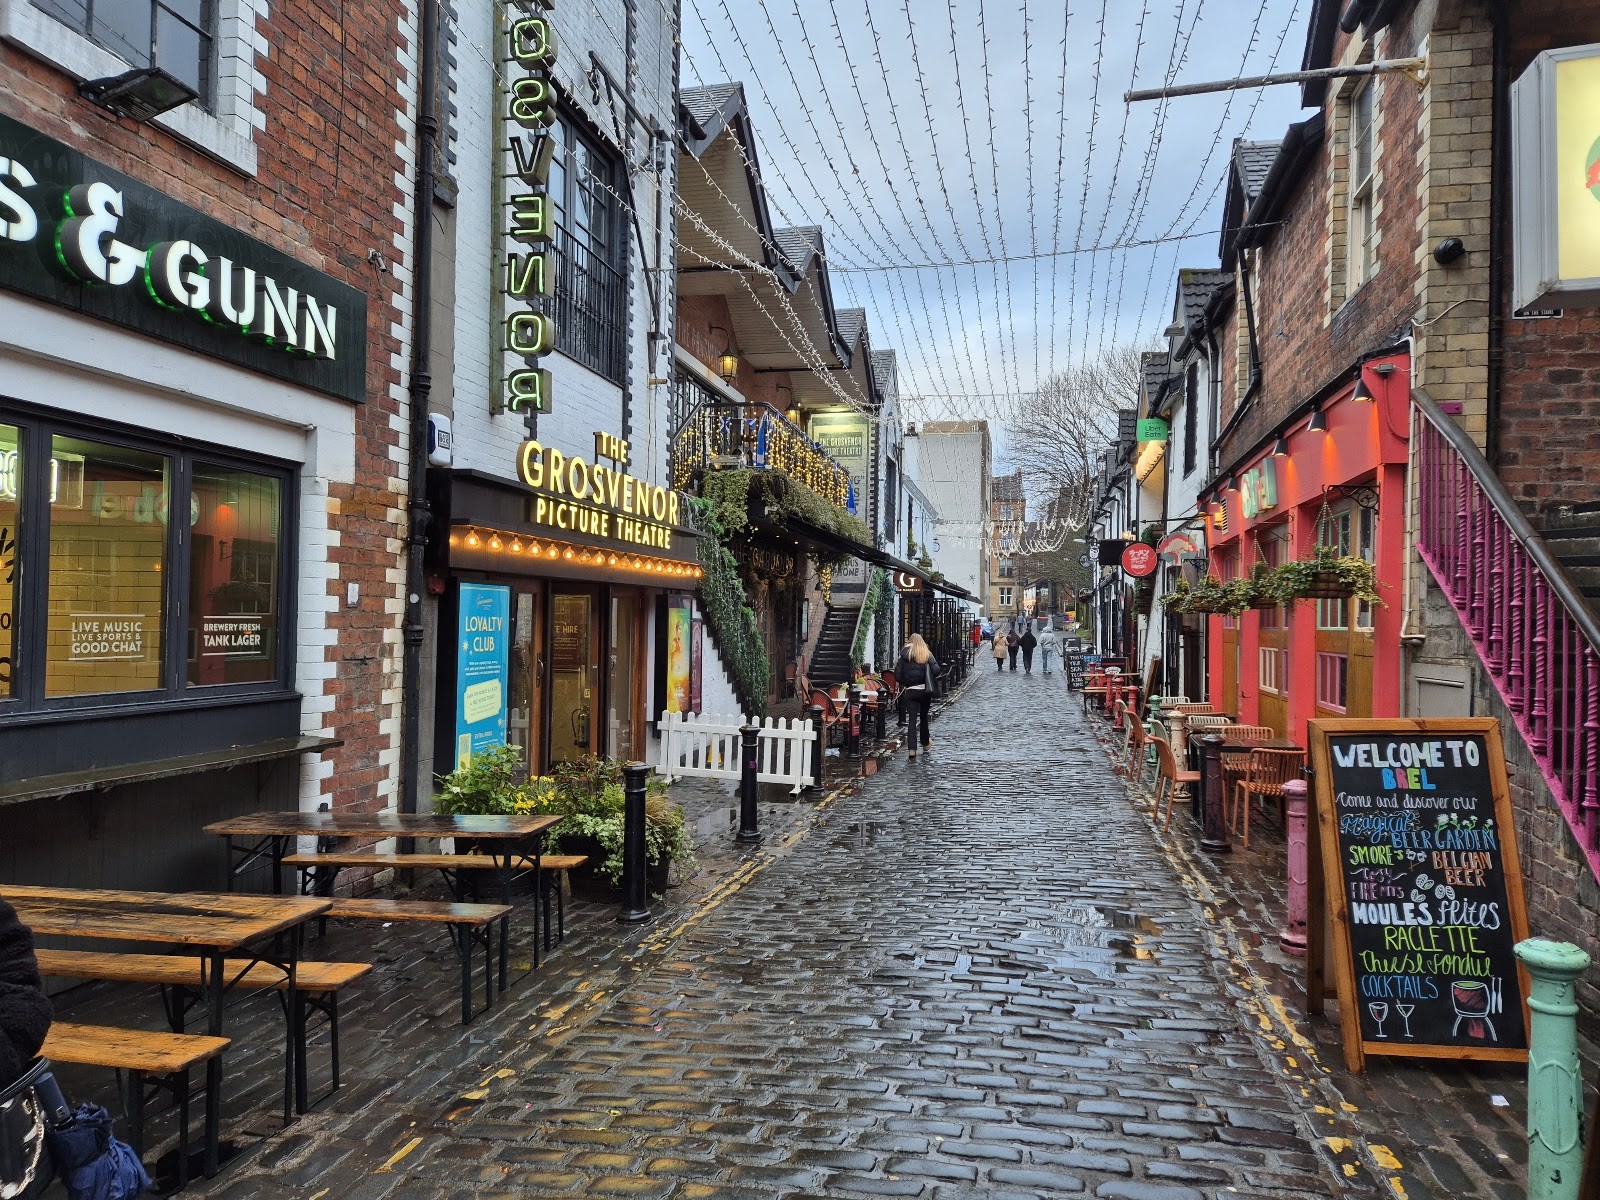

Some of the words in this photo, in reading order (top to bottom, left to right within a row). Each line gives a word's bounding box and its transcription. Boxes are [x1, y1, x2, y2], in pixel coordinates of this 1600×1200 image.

[79, 181, 149, 286] &
[166, 240, 337, 361] GUNN
[594, 432, 631, 464] THE
[830, 436, 861, 446] GROSVENOR
[840, 446, 861, 455] THEATRE
[518, 440, 679, 527] GROSVENOR
[537, 502, 609, 538] PICTURE
[617, 516, 672, 550] THEATRE
[71, 622, 99, 633] LIVE
[103, 622, 142, 632] MUSIC
[204, 623, 237, 631] BREWERY
[239, 623, 261, 631] FRESH
[465, 616, 502, 632] LOYALTY
[562, 625, 578, 634] HIRE
[97, 633, 132, 641] SPORTS
[203, 634, 229, 646] TANK
[231, 634, 261, 646] LAGER
[473, 636, 494, 652] CLUB
[71, 642, 109, 654] GOOD
[111, 641, 142, 653] CHAT
[1333, 741, 1444, 768] WELCOME
[1445, 740, 1480, 768] TO
[1381, 769, 1436, 790] BREL
[1335, 791, 1372, 808] Come
[1376, 793, 1398, 808] and
[1403, 793, 1449, 808] discover
[1452, 797, 1478, 809] our
[1391, 830, 1432, 849] BEER
[1434, 829, 1497, 850] GARDEN
[1432, 851, 1493, 870] BELGIAN
[1445, 870, 1487, 887] BEER
[1351, 902, 1434, 926] MOULES
[1384, 926, 1487, 954] RACLETTE
[1360, 975, 1440, 1000] COCKTAILS
